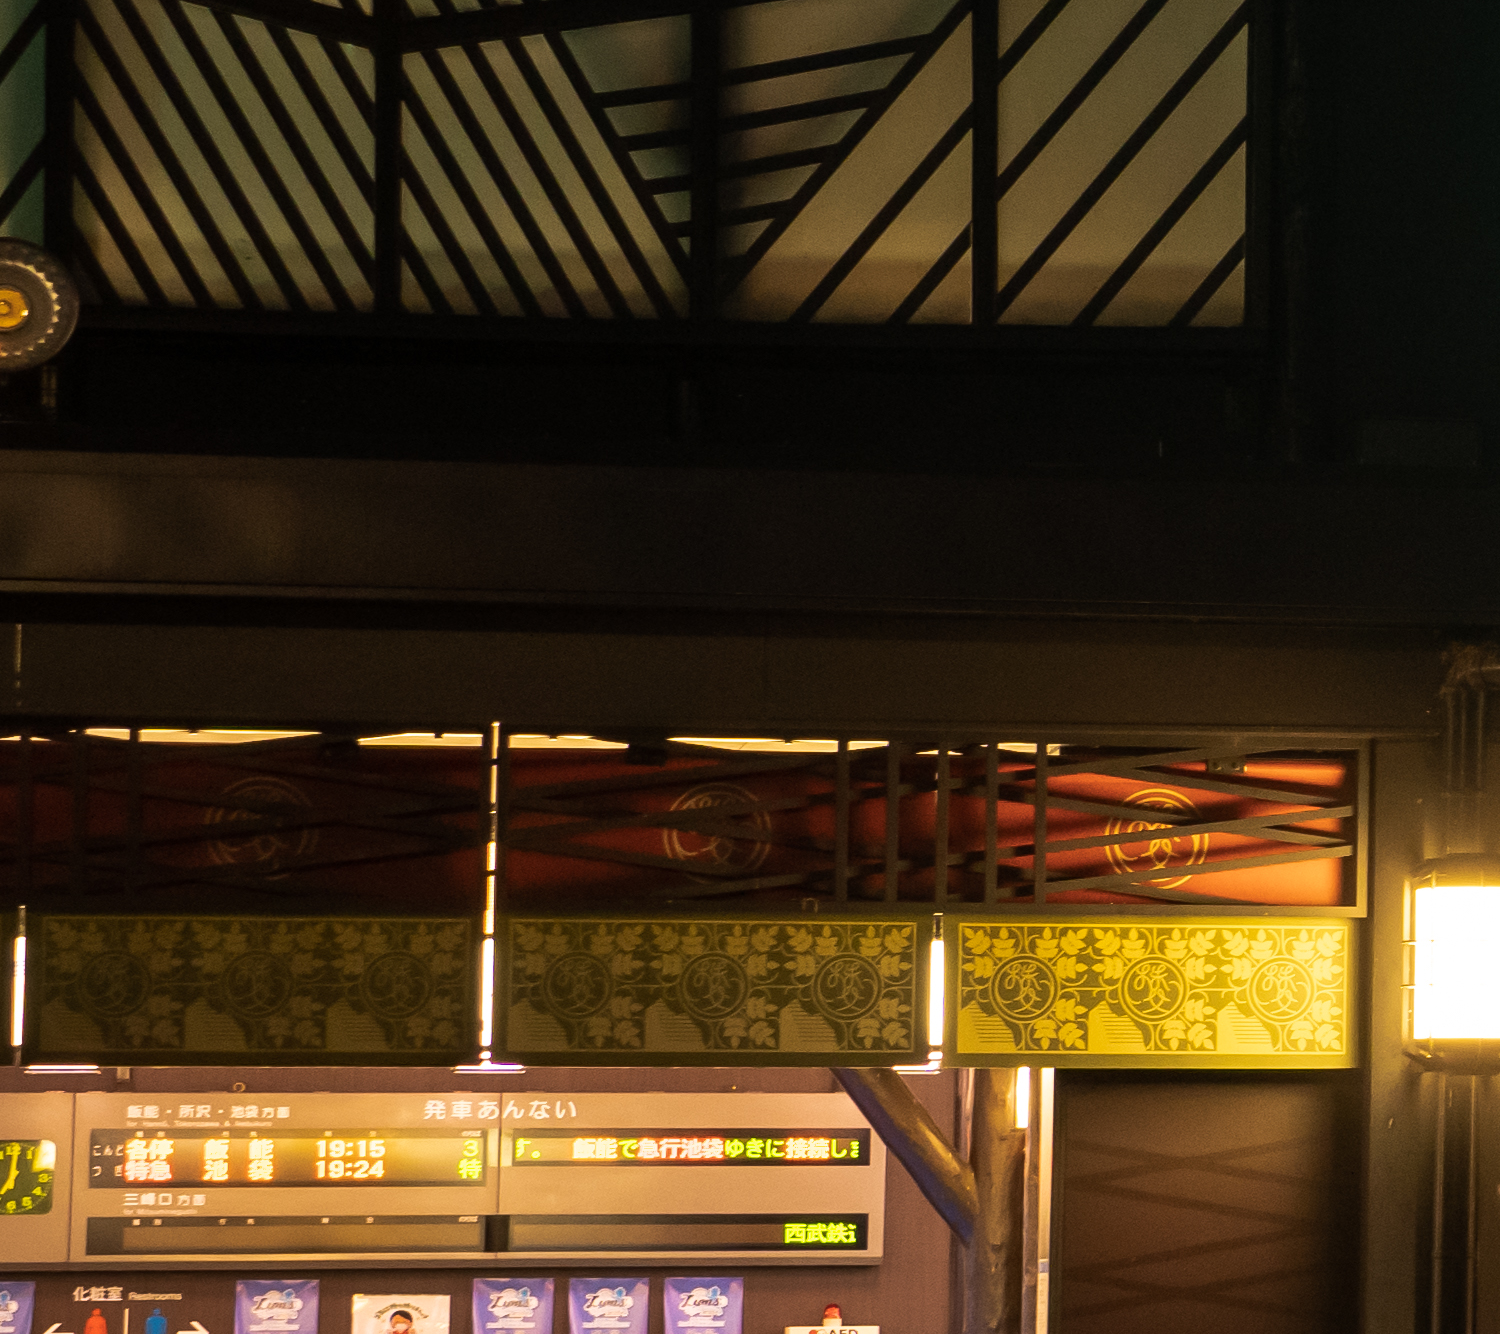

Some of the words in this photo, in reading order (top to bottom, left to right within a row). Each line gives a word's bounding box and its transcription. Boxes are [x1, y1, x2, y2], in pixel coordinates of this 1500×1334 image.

[127, 1105, 290, 1119] 飯能・所沢・池袋方面
[423, 1099, 577, 1120] 発車あんない
[126, 1139, 174, 1160] 各停
[205, 1139, 274, 1160] 飯能
[316, 1140, 385, 1157] 19:15
[462, 1139, 479, 1157] 3
[125, 1160, 172, 1181] 特急
[203, 1160, 274, 1181] 池袋
[316, 1160, 385, 1179] 19:24
[457, 1160, 482, 1180] 特
[73, 1286, 123, 1302] 化粧室
